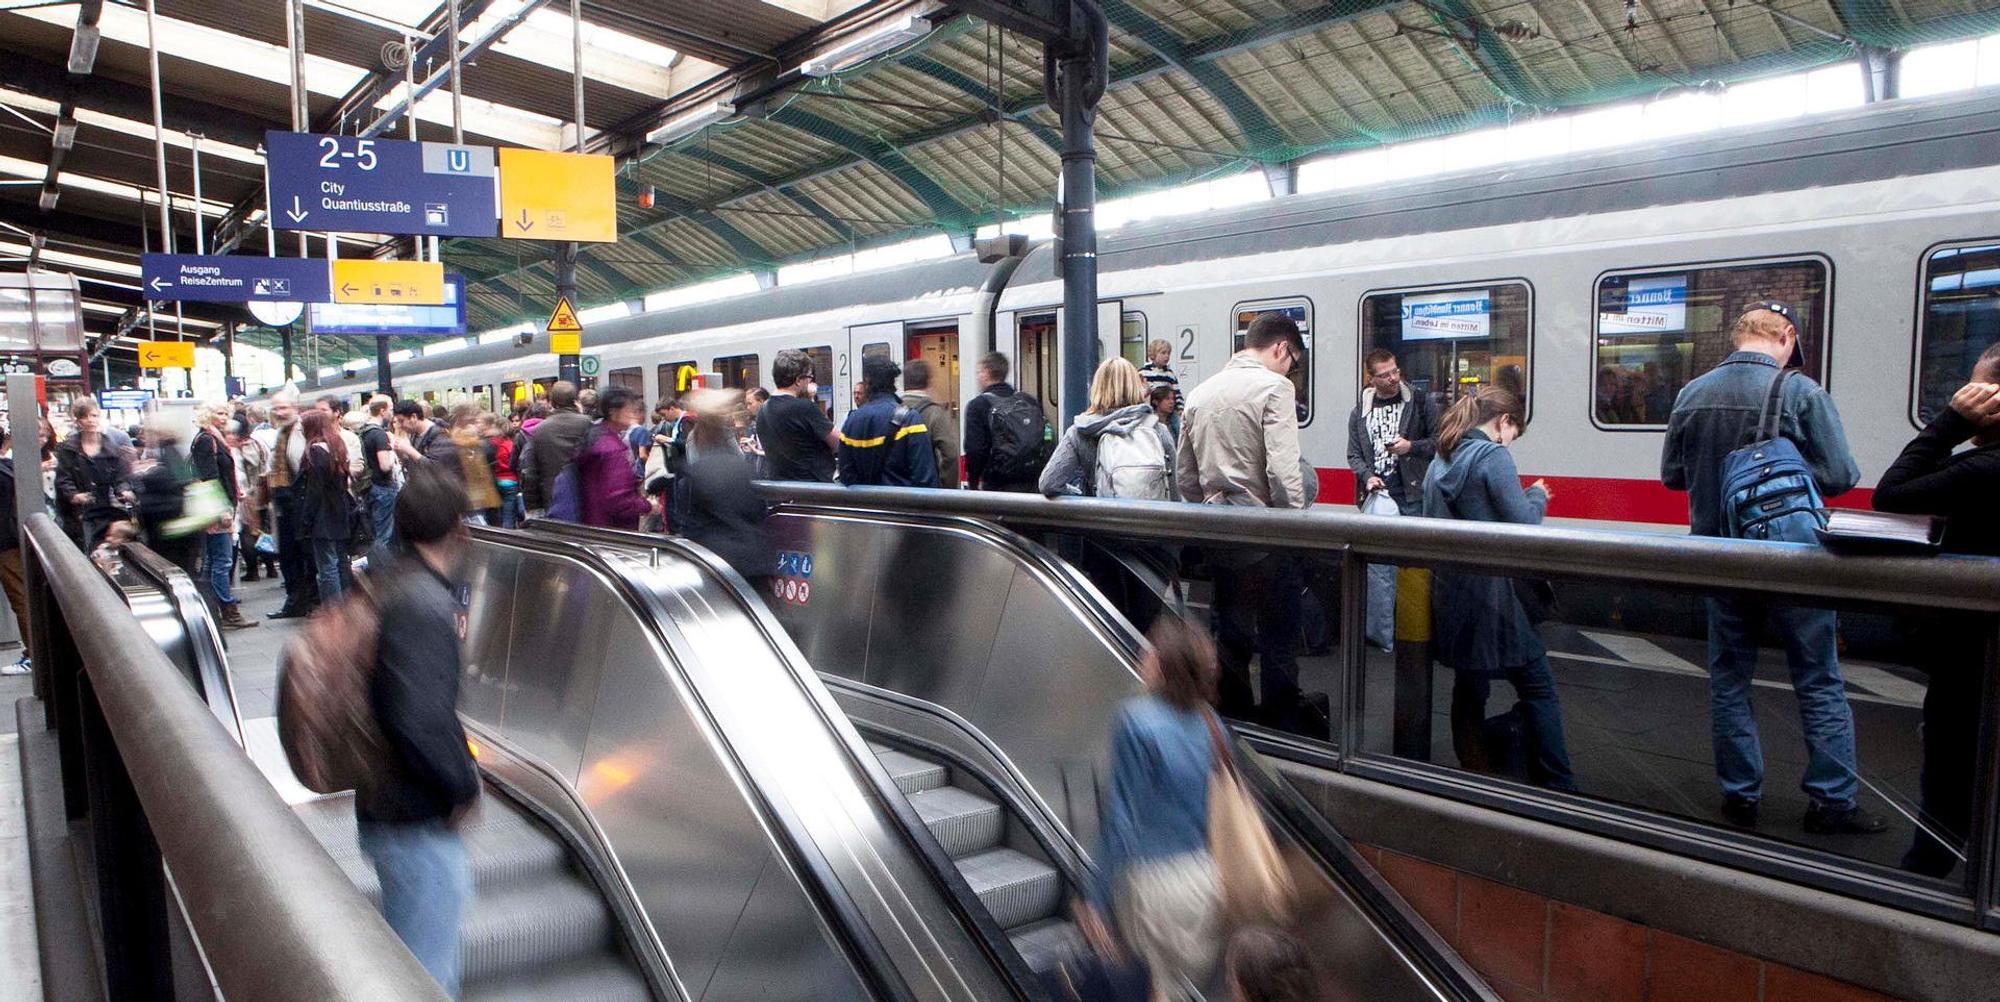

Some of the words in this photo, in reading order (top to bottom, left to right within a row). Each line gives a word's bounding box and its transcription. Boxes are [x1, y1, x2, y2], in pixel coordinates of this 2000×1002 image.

[319, 137, 378, 171] 2-5
[450, 151, 466, 171] U
[320, 181, 345, 196] City
[321, 197, 411, 213] Quantiusstraße
[180, 265, 221, 276] Ausgang
[180, 276, 243, 287] ReiseZentrum
[1180, 328, 1195, 360] 2
[839, 353, 848, 376] 2
